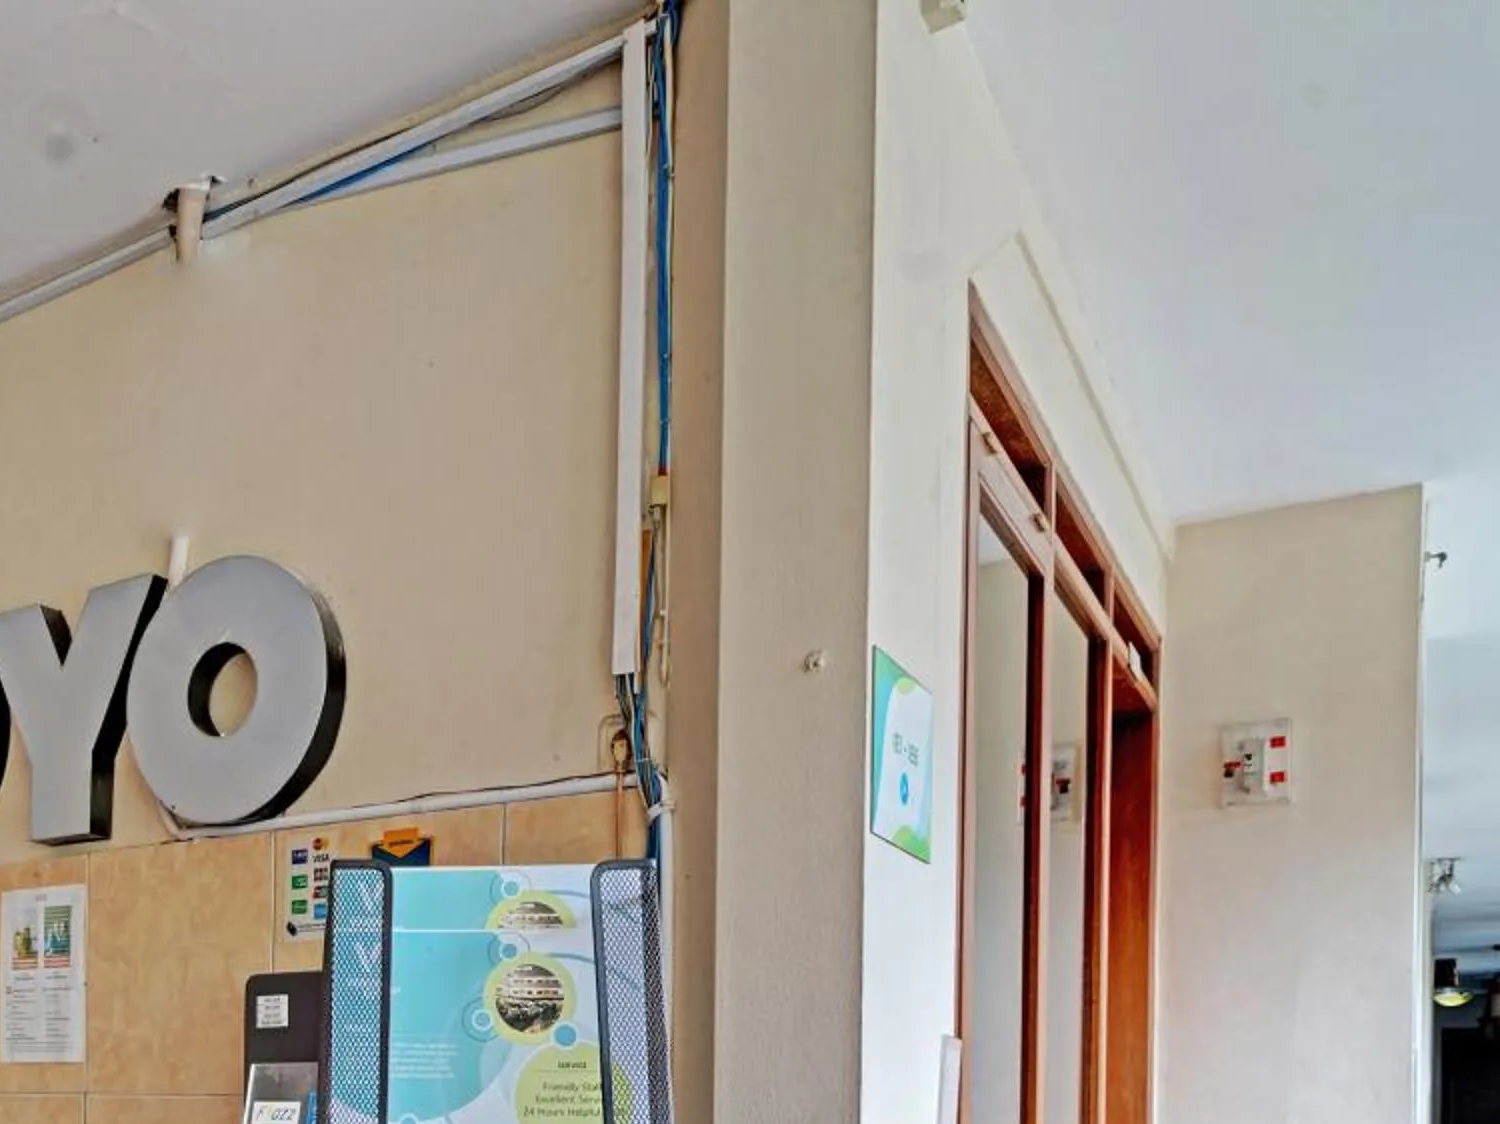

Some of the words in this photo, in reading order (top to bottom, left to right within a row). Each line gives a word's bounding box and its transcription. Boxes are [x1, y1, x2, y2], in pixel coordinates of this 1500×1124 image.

[312, 853, 329, 862] VISA
[523, 1106, 535, 1116] 24
[537, 1106, 565, 1116] Hours
